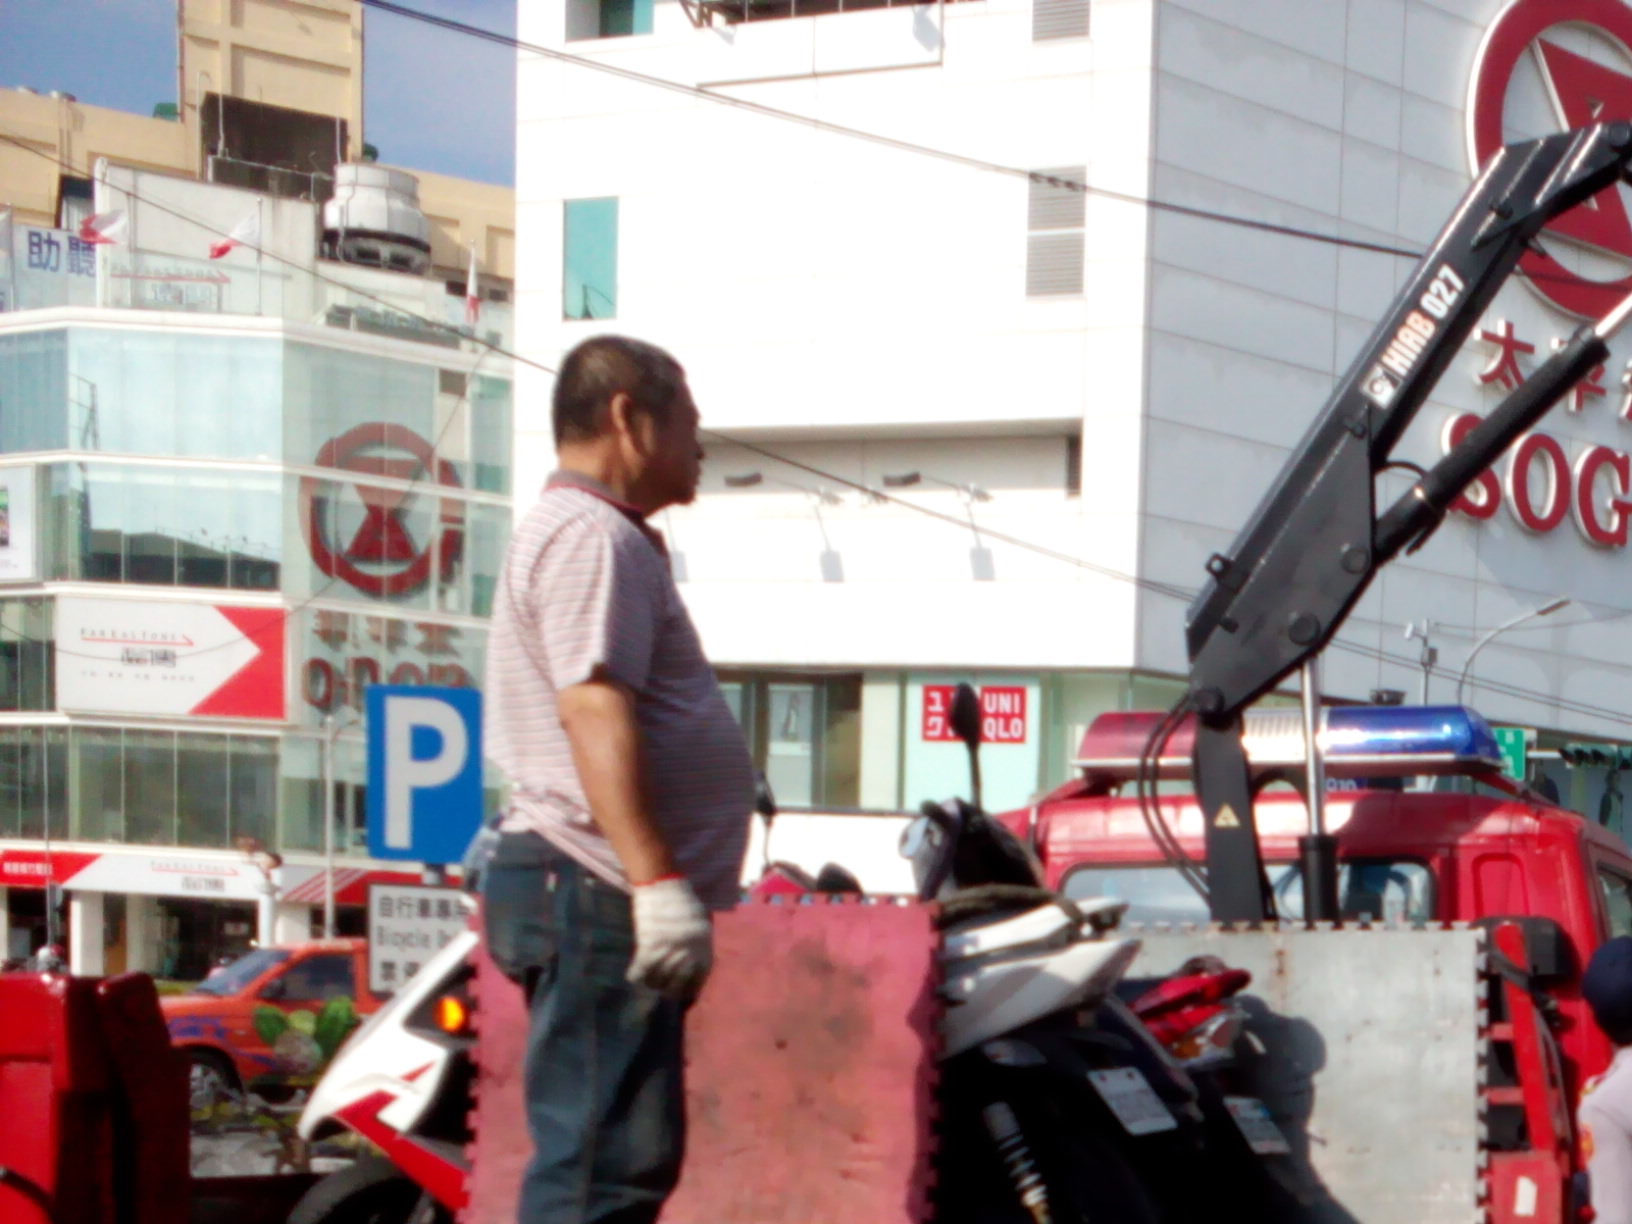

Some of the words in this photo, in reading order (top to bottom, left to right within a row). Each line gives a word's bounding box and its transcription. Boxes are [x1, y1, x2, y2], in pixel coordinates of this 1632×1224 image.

[1420, 263, 1465, 320] 027
[983, 692, 1022, 715] UNI
[982, 717, 1024, 741] QLO
[384, 695, 469, 850] P
